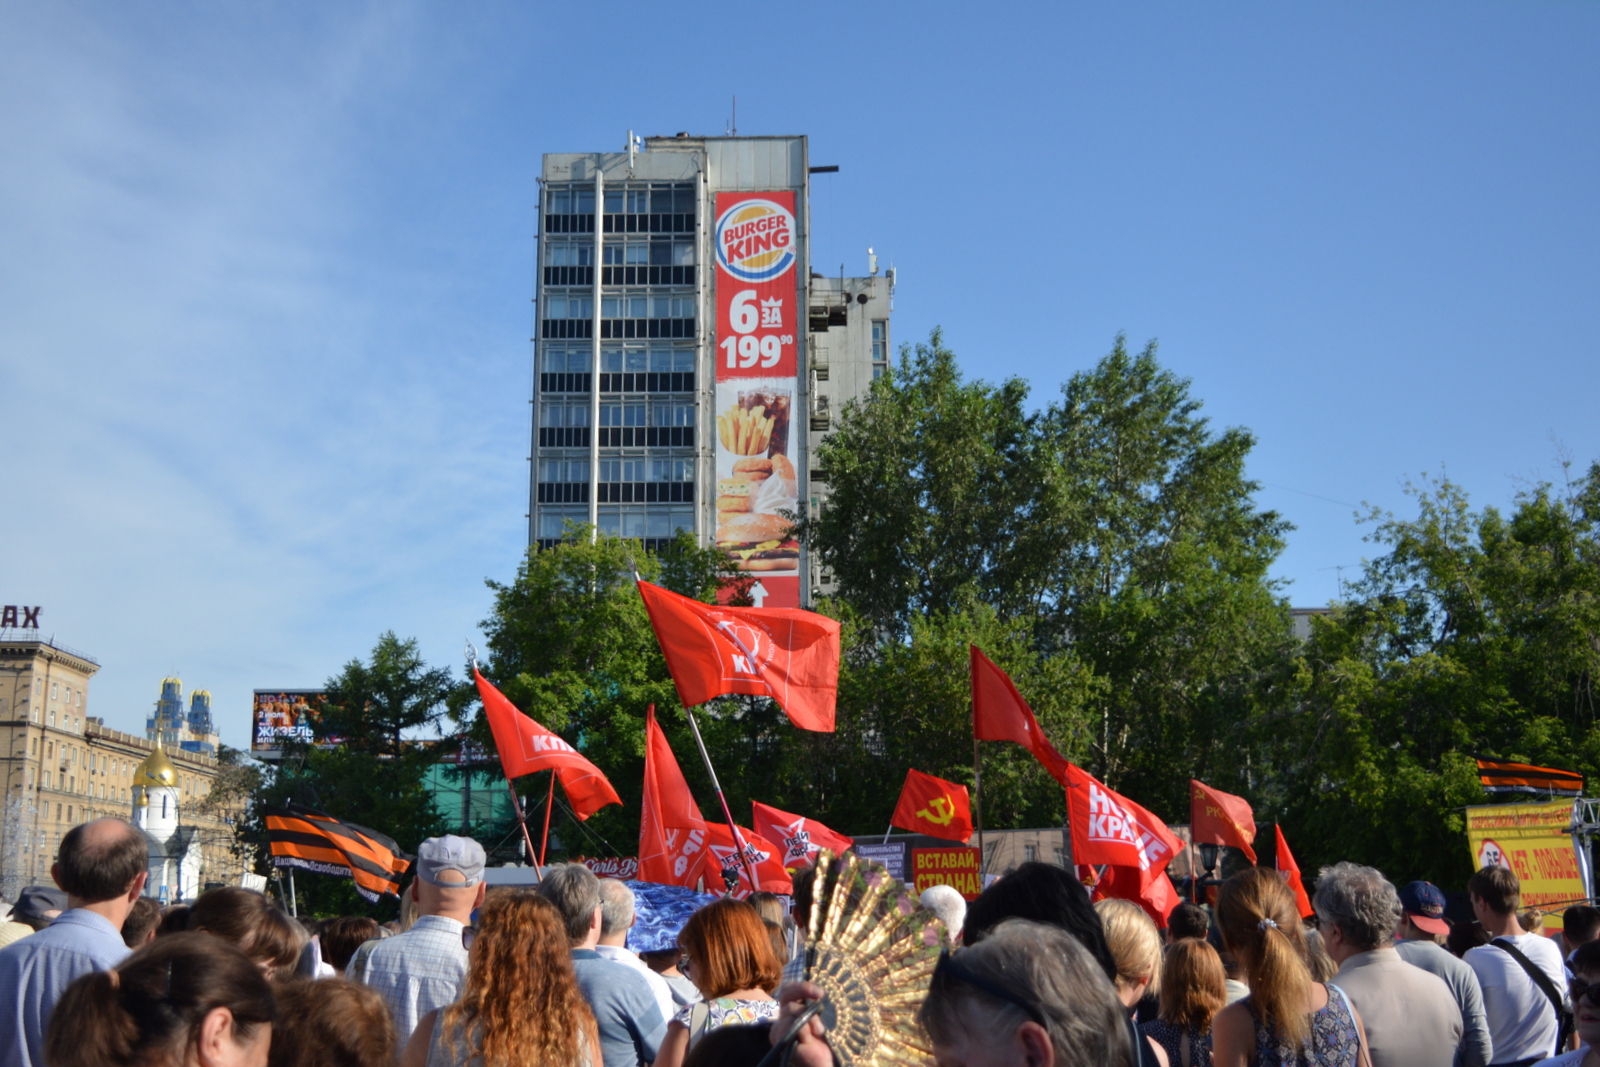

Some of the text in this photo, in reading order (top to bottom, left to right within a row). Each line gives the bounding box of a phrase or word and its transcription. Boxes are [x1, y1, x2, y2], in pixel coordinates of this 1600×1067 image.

[723, 215, 787, 245] BURGER
[727, 228, 790, 265] KING
[729, 289, 759, 334] 6
[719, 334, 782, 369] 199
[257, 726, 314, 737] ЖИЗЕЛЬ
[532, 735, 577, 753] КП
[917, 849, 979, 871] ВСТАВАЙ,
